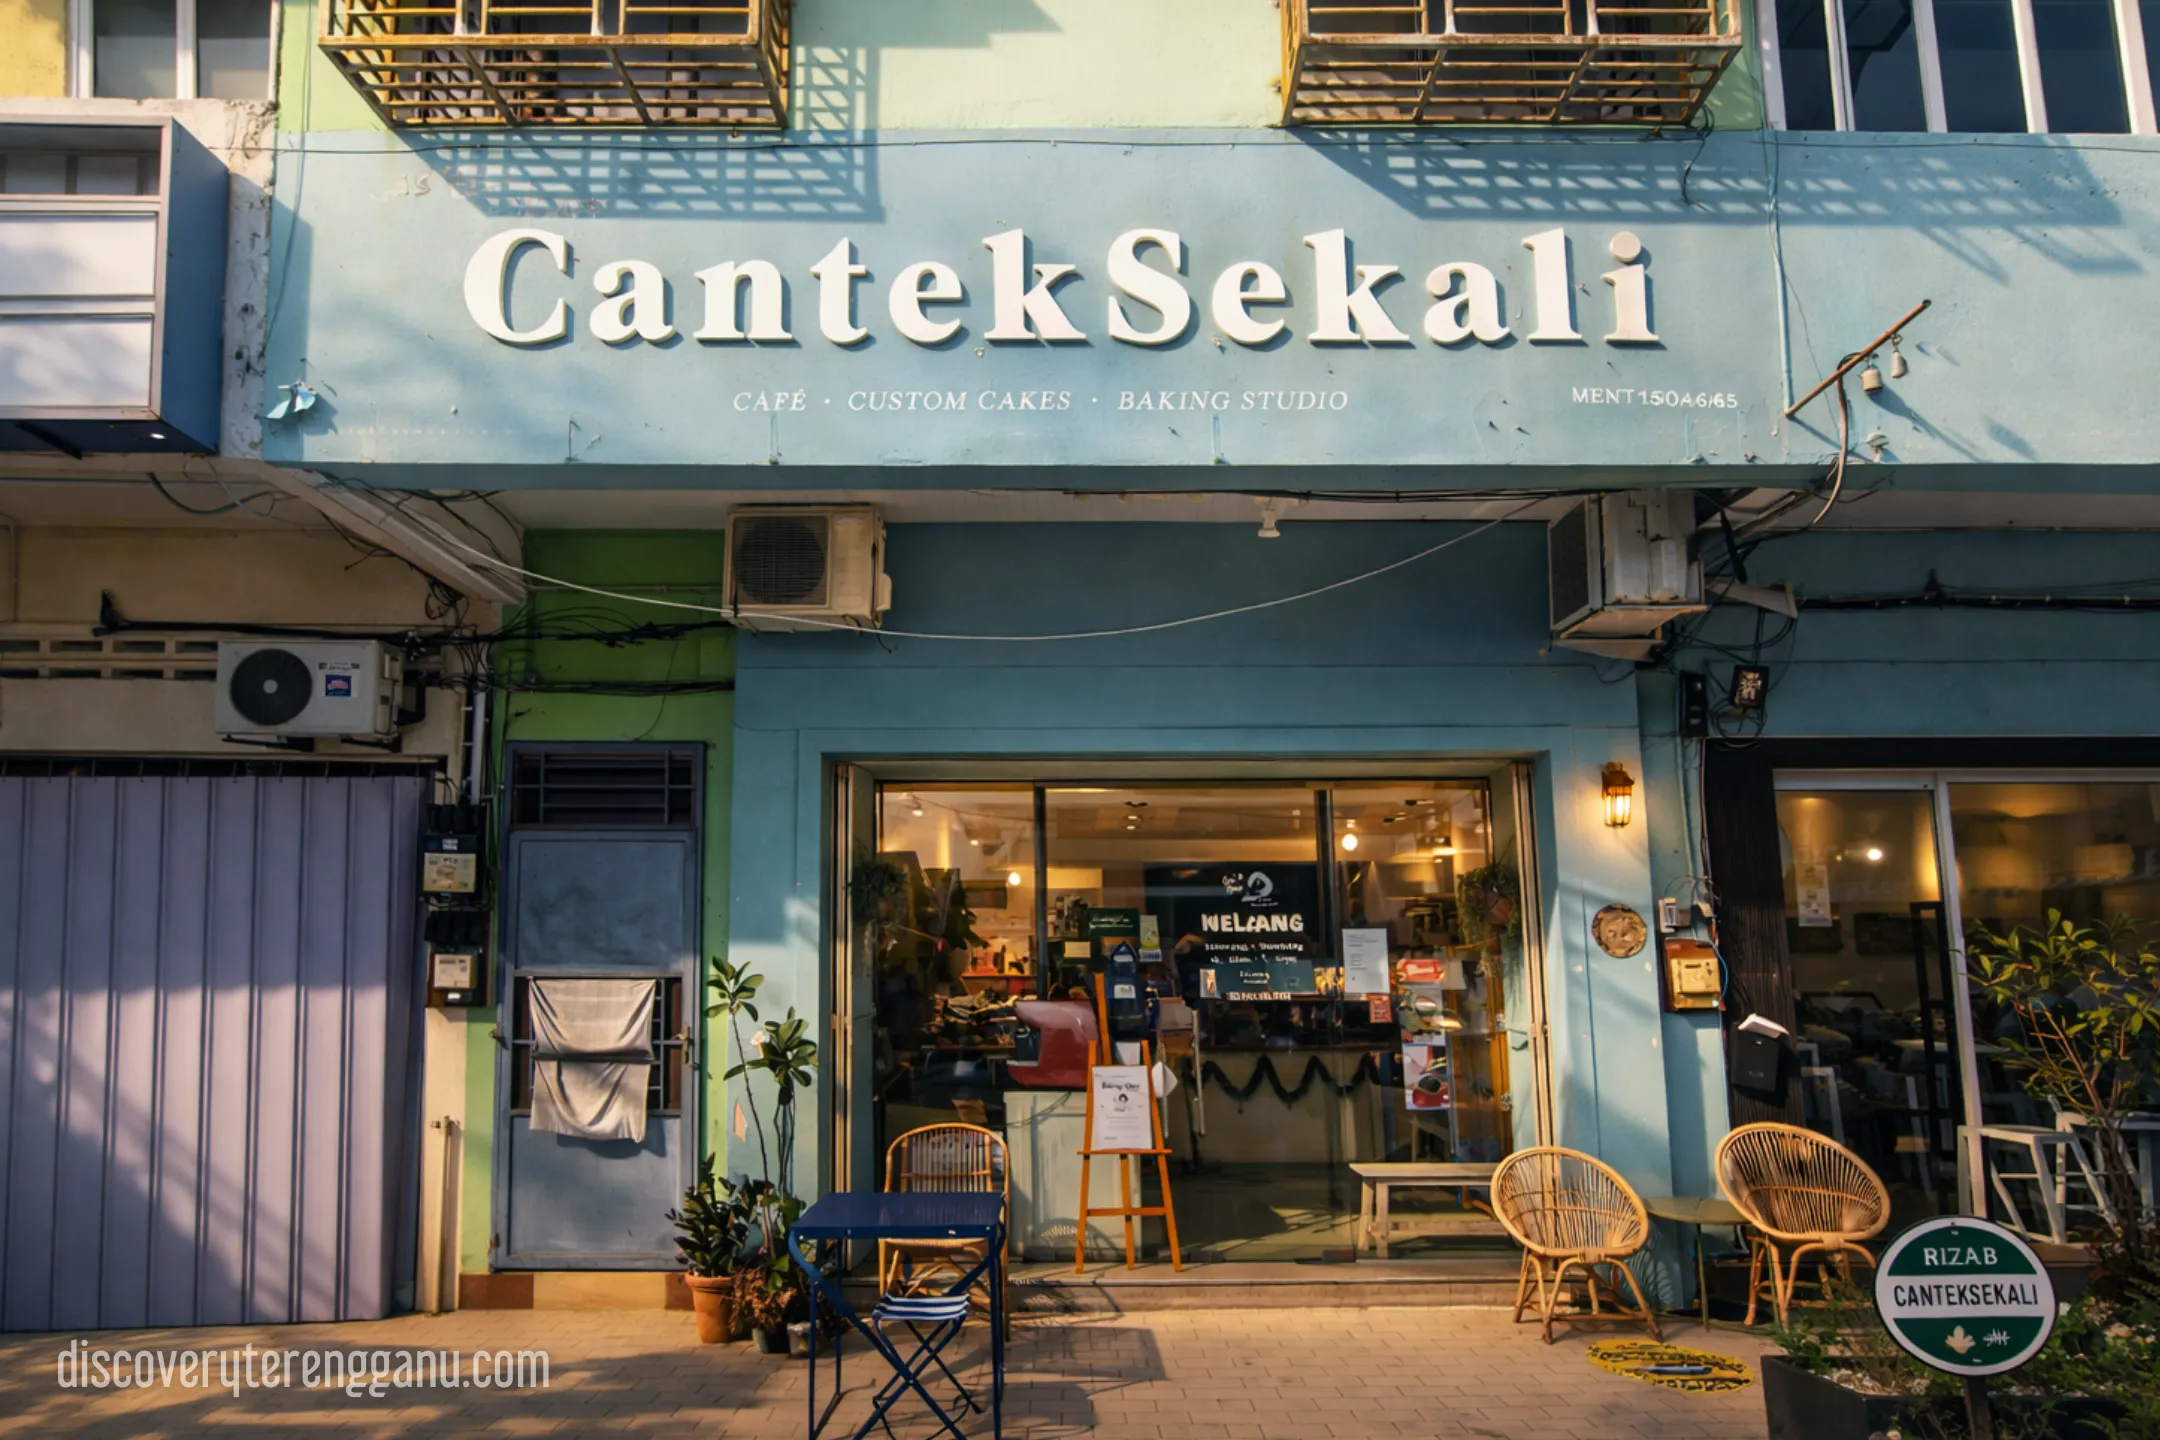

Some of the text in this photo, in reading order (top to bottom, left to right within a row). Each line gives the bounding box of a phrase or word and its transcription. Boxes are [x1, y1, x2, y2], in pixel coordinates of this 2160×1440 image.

[463, 227, 1663, 348] CantekSekali
[732, 388, 1348, 412] CAFÉ CUSTOM CAKES BAKING STUDIO
[1923, 1246, 1998, 1267] RIZAB
[1893, 1283, 2039, 1307] CANTEKSEKALI
